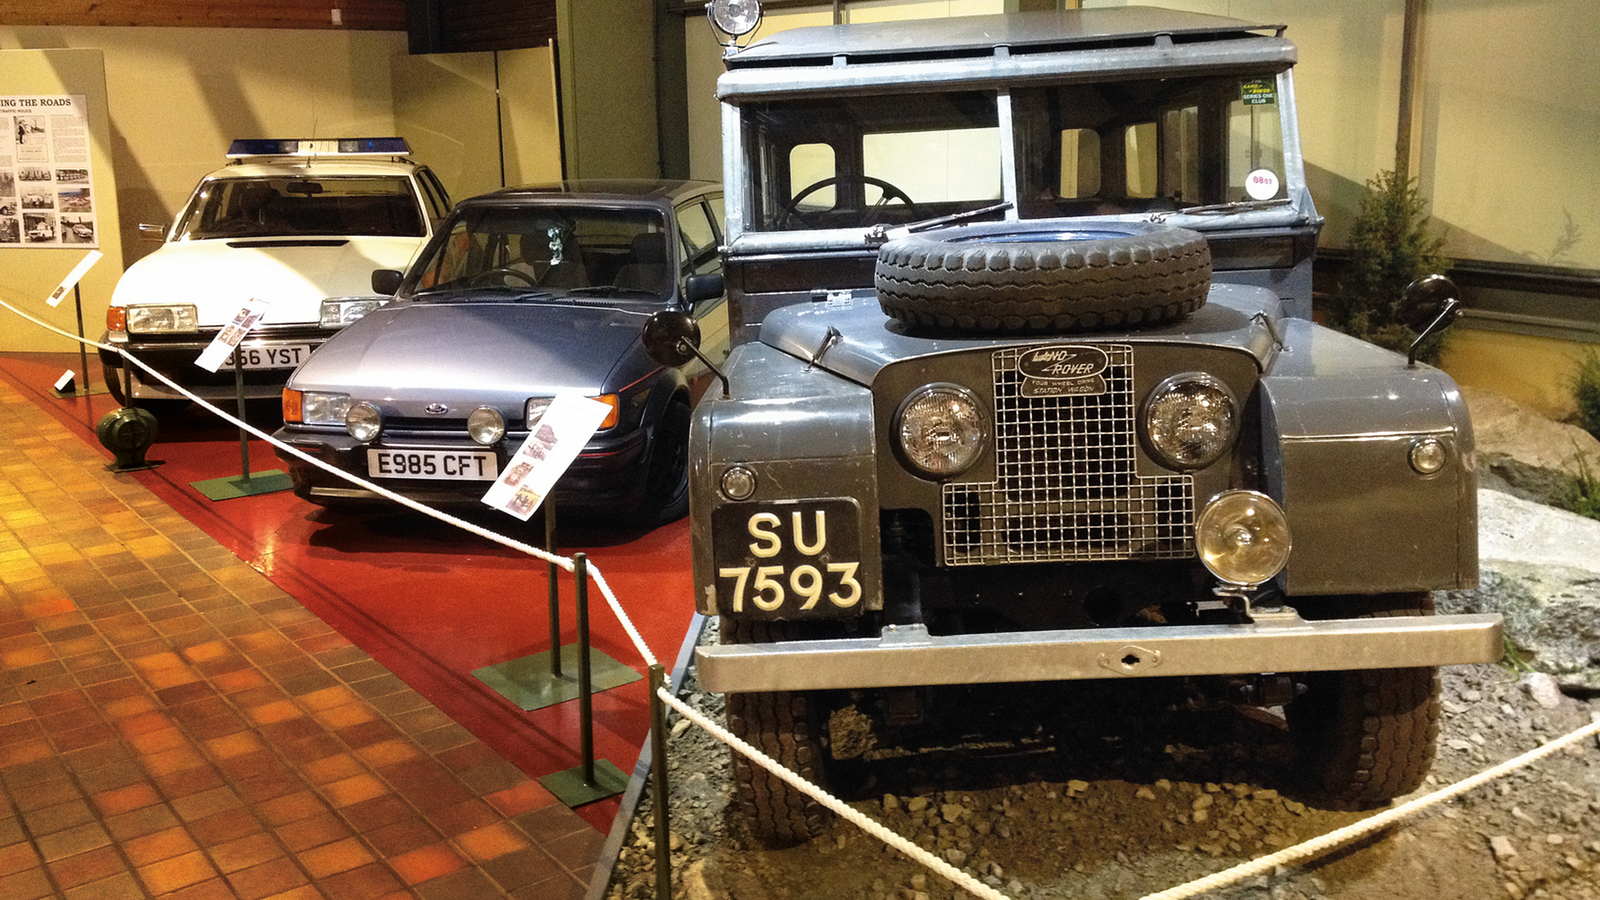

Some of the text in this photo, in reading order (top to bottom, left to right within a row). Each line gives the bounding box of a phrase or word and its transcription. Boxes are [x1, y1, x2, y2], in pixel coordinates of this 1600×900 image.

[19, 99, 37, 107] THE
[40, 98, 71, 107] ROADS
[224, 348, 302, 366] 356 YST
[1032, 350, 1068, 362] LAND
[1051, 363, 1095, 375] ROVER
[377, 452, 487, 477] E985 CFT
[747, 510, 827, 558] SU
[719, 561, 862, 612] 7593
